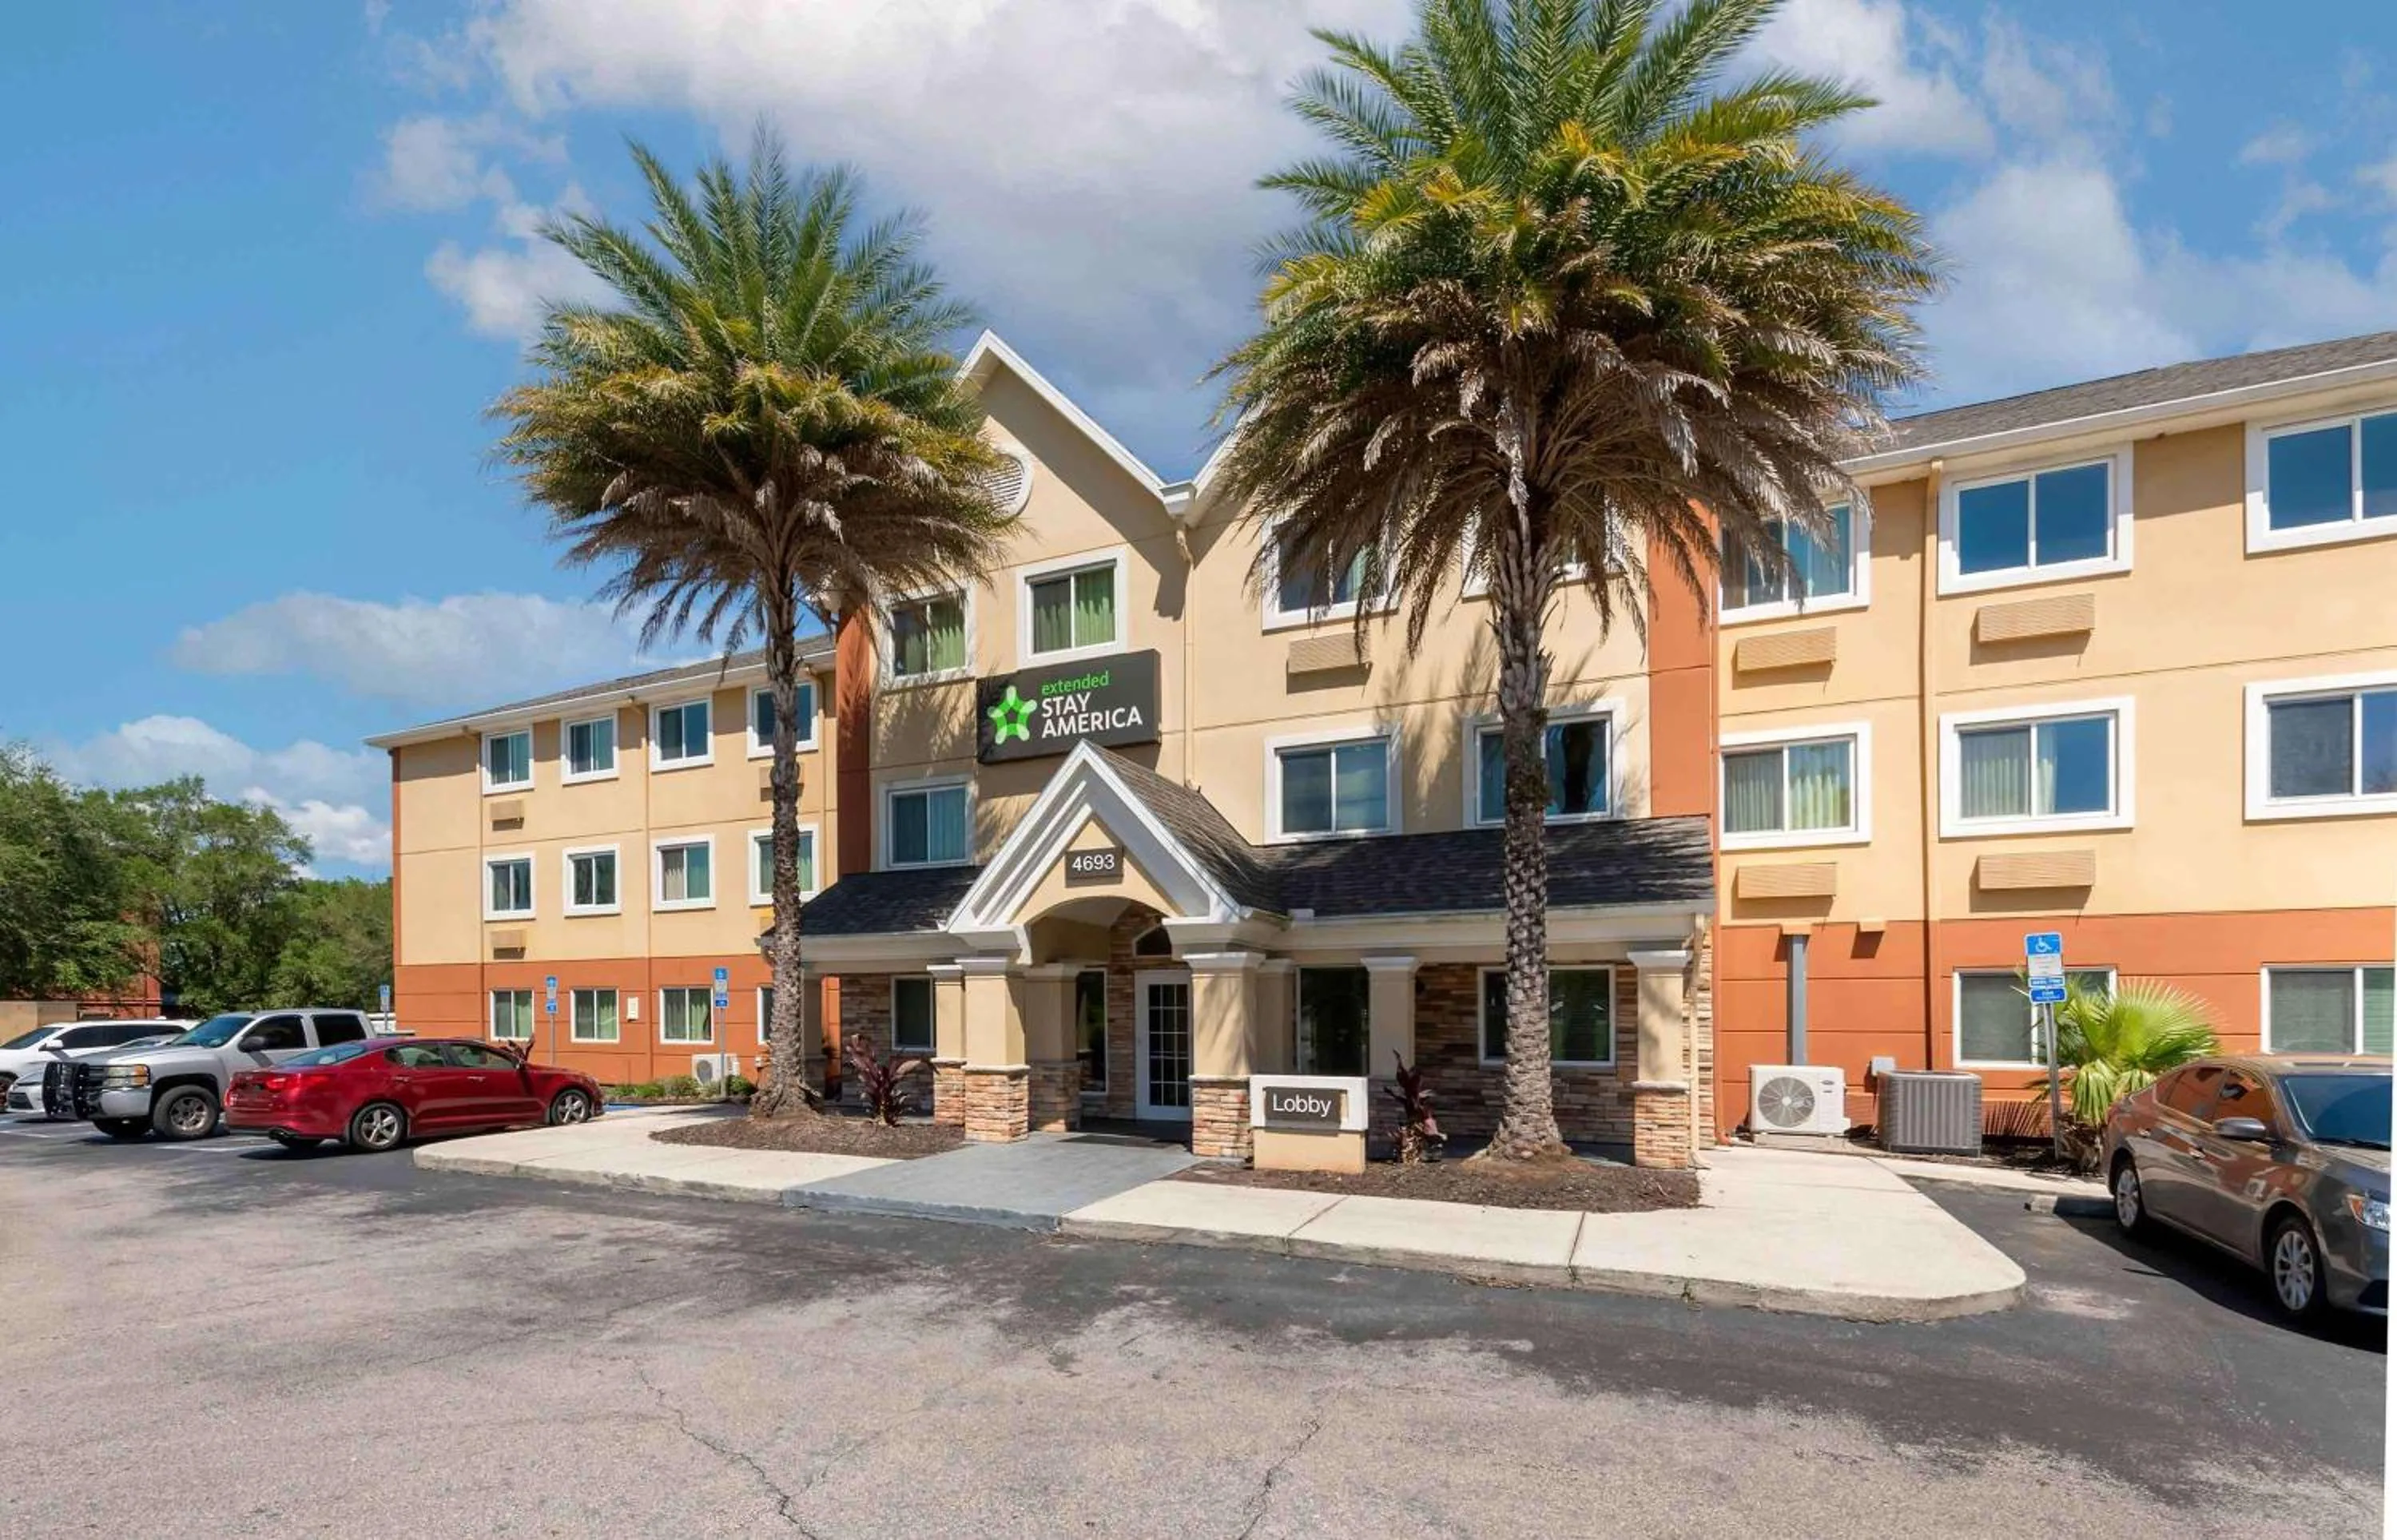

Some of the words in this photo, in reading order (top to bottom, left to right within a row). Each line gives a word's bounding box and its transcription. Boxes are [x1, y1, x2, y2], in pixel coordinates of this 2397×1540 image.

[1041, 670, 1110, 696] extended
[1041, 692, 1091, 718] STAY
[1041, 706, 1143, 739] AMERICA
[1071, 854, 1115, 871] 4693
[1273, 1093, 1332, 1117] Lobby
